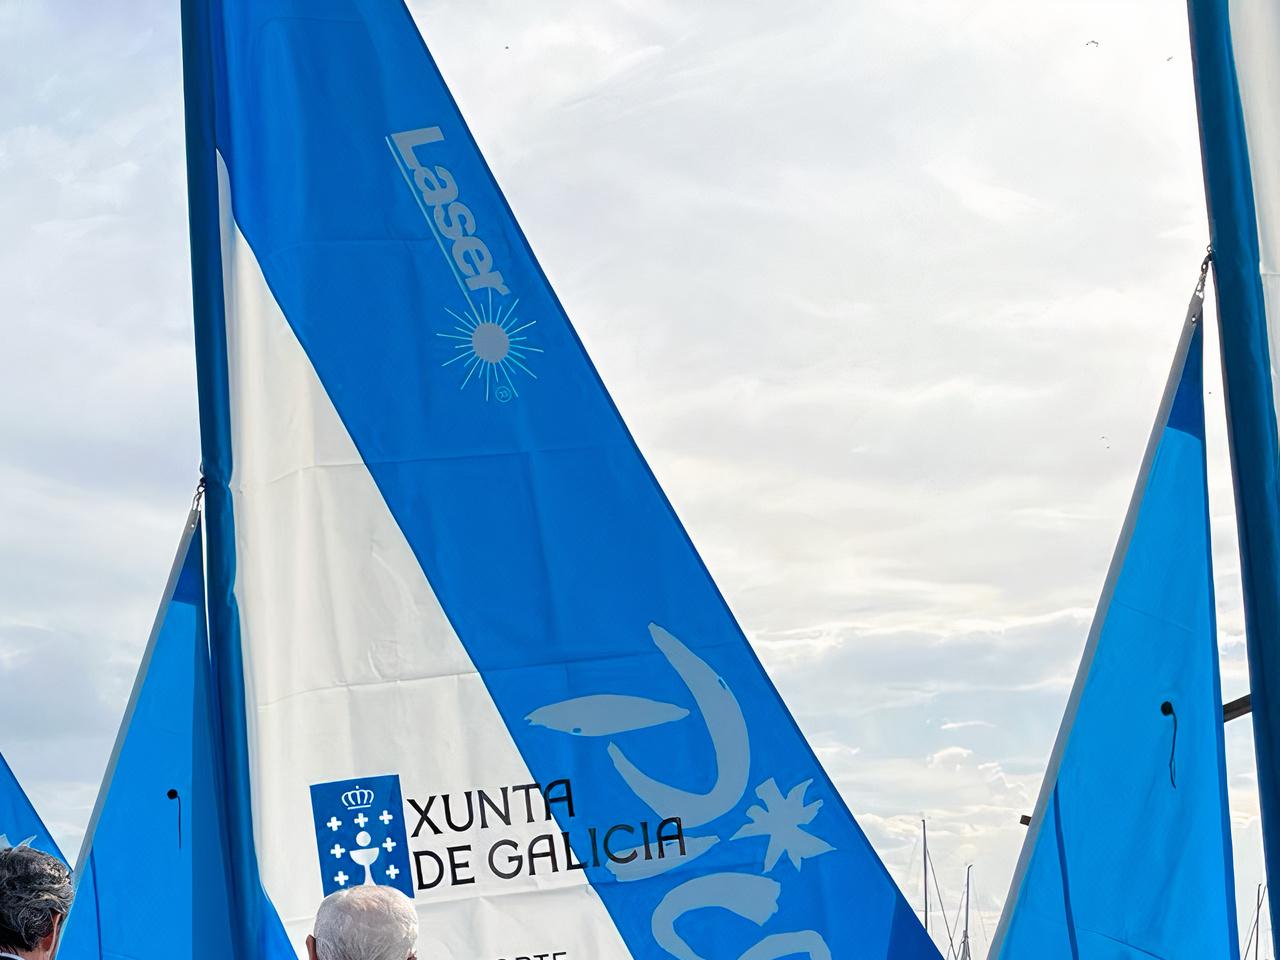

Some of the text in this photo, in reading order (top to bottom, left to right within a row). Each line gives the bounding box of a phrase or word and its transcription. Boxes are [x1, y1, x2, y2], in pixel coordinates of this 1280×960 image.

[390, 126, 511, 296] Laser
[407, 778, 576, 838] XUNTA
[413, 815, 687, 890] DE GALICIA
